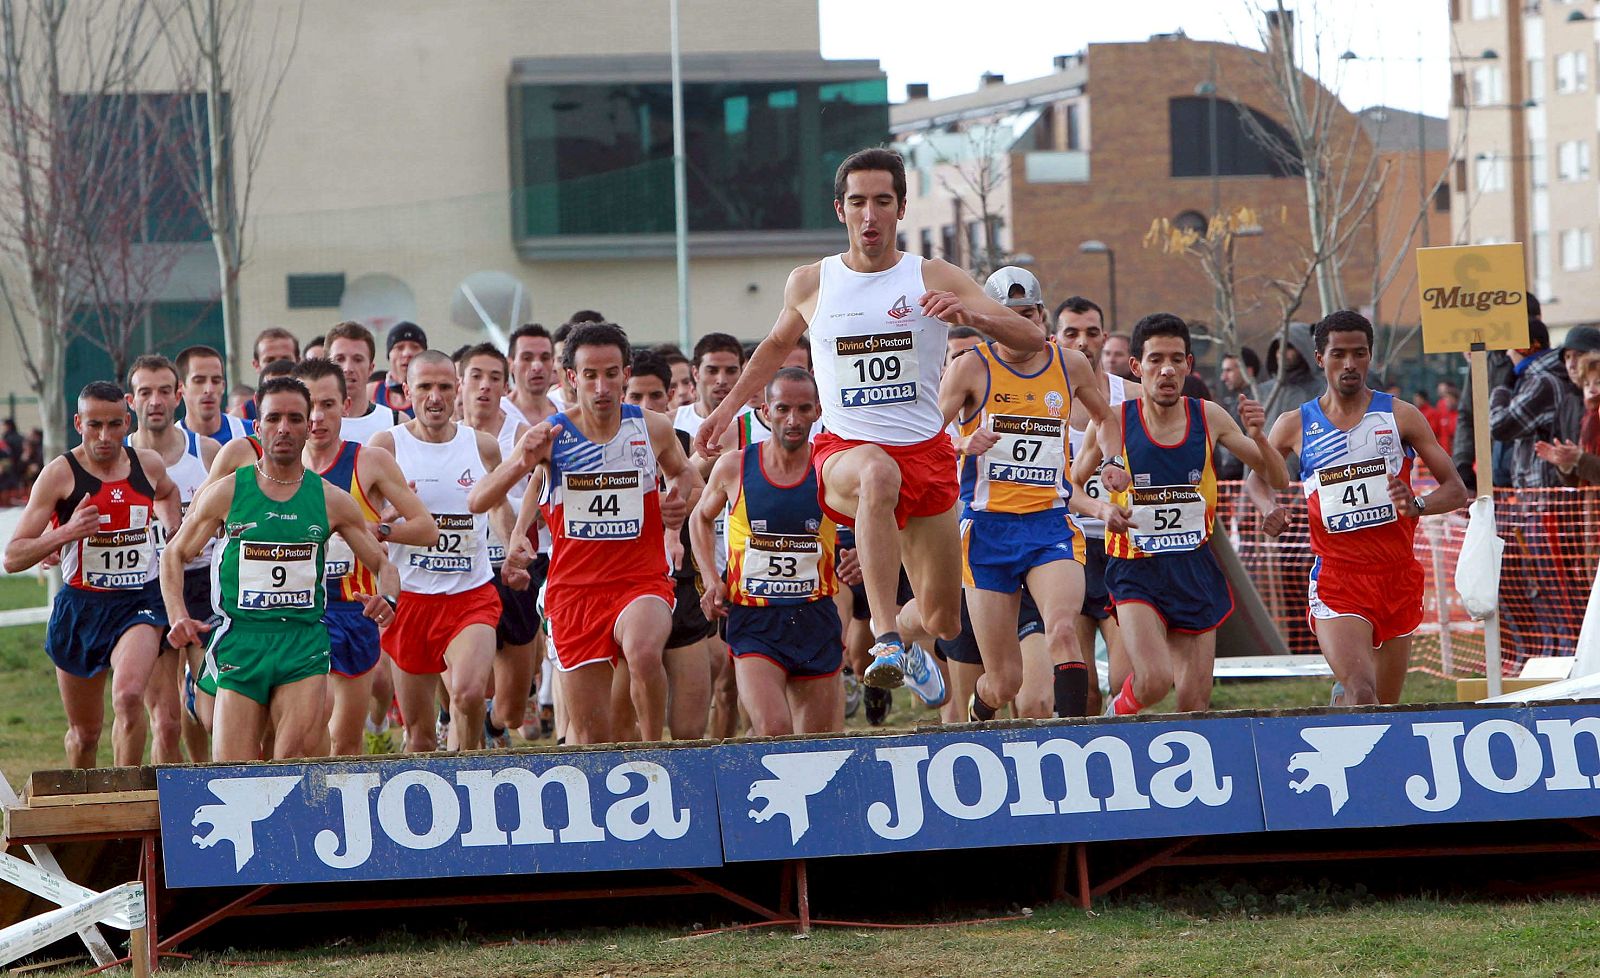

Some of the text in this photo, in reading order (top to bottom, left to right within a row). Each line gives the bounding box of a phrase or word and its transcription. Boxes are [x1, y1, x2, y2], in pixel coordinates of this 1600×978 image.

[1423, 286, 1522, 311] Muga
[838, 341, 865, 351] Divina
[880, 337, 911, 347] Pastora
[853, 355, 901, 383] 109
[860, 384, 914, 404] Joma
[994, 420, 1020, 430] Divina
[1012, 438, 1043, 463] 67
[568, 477, 594, 487] Divina
[608, 475, 637, 486] Pastora
[1007, 466, 1054, 482] Joma
[1320, 471, 1344, 483] Divina
[1356, 462, 1385, 475] Pastora
[1134, 493, 1158, 501] Divina
[1342, 482, 1370, 507] 41
[588, 494, 621, 517] 44
[447, 518, 473, 527] Pastora
[1154, 508, 1182, 531] 52
[1345, 506, 1391, 528] Joma
[587, 521, 638, 538] Joma
[751, 538, 774, 547] Divina
[788, 540, 817, 549] Pastora
[1152, 532, 1200, 550] Joma
[100, 549, 140, 570] 119
[245, 547, 271, 557] Divina
[285, 547, 311, 558] Pastora
[426, 556, 470, 570] Joma
[768, 555, 798, 578] 53
[271, 565, 287, 588] 9
[763, 580, 813, 595] Joma
[260, 591, 309, 608] Joma
[867, 730, 1232, 840] Joma
[313, 761, 691, 869] Joma
